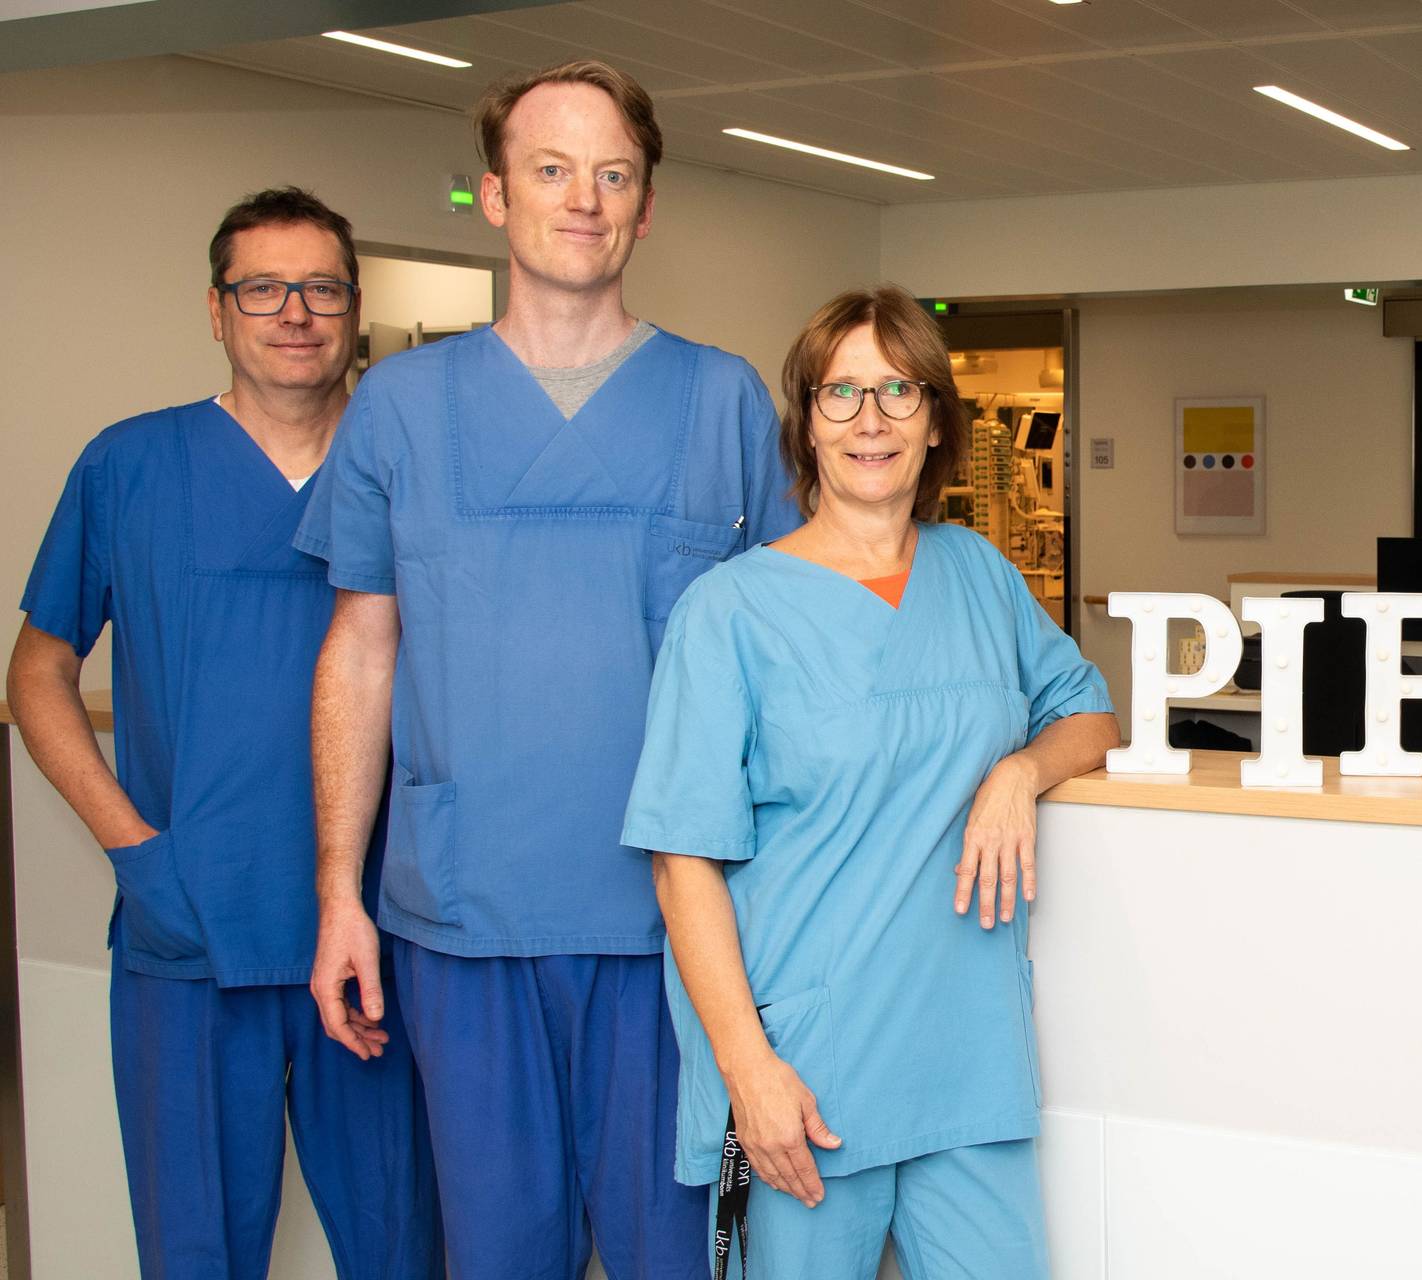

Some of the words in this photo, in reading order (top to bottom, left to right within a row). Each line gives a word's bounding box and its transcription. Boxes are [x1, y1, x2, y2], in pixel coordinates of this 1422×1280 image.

[1095, 455, 1109, 465] 105
[724, 1131, 741, 1157] ukb
[715, 1229, 730, 1256] ukb
